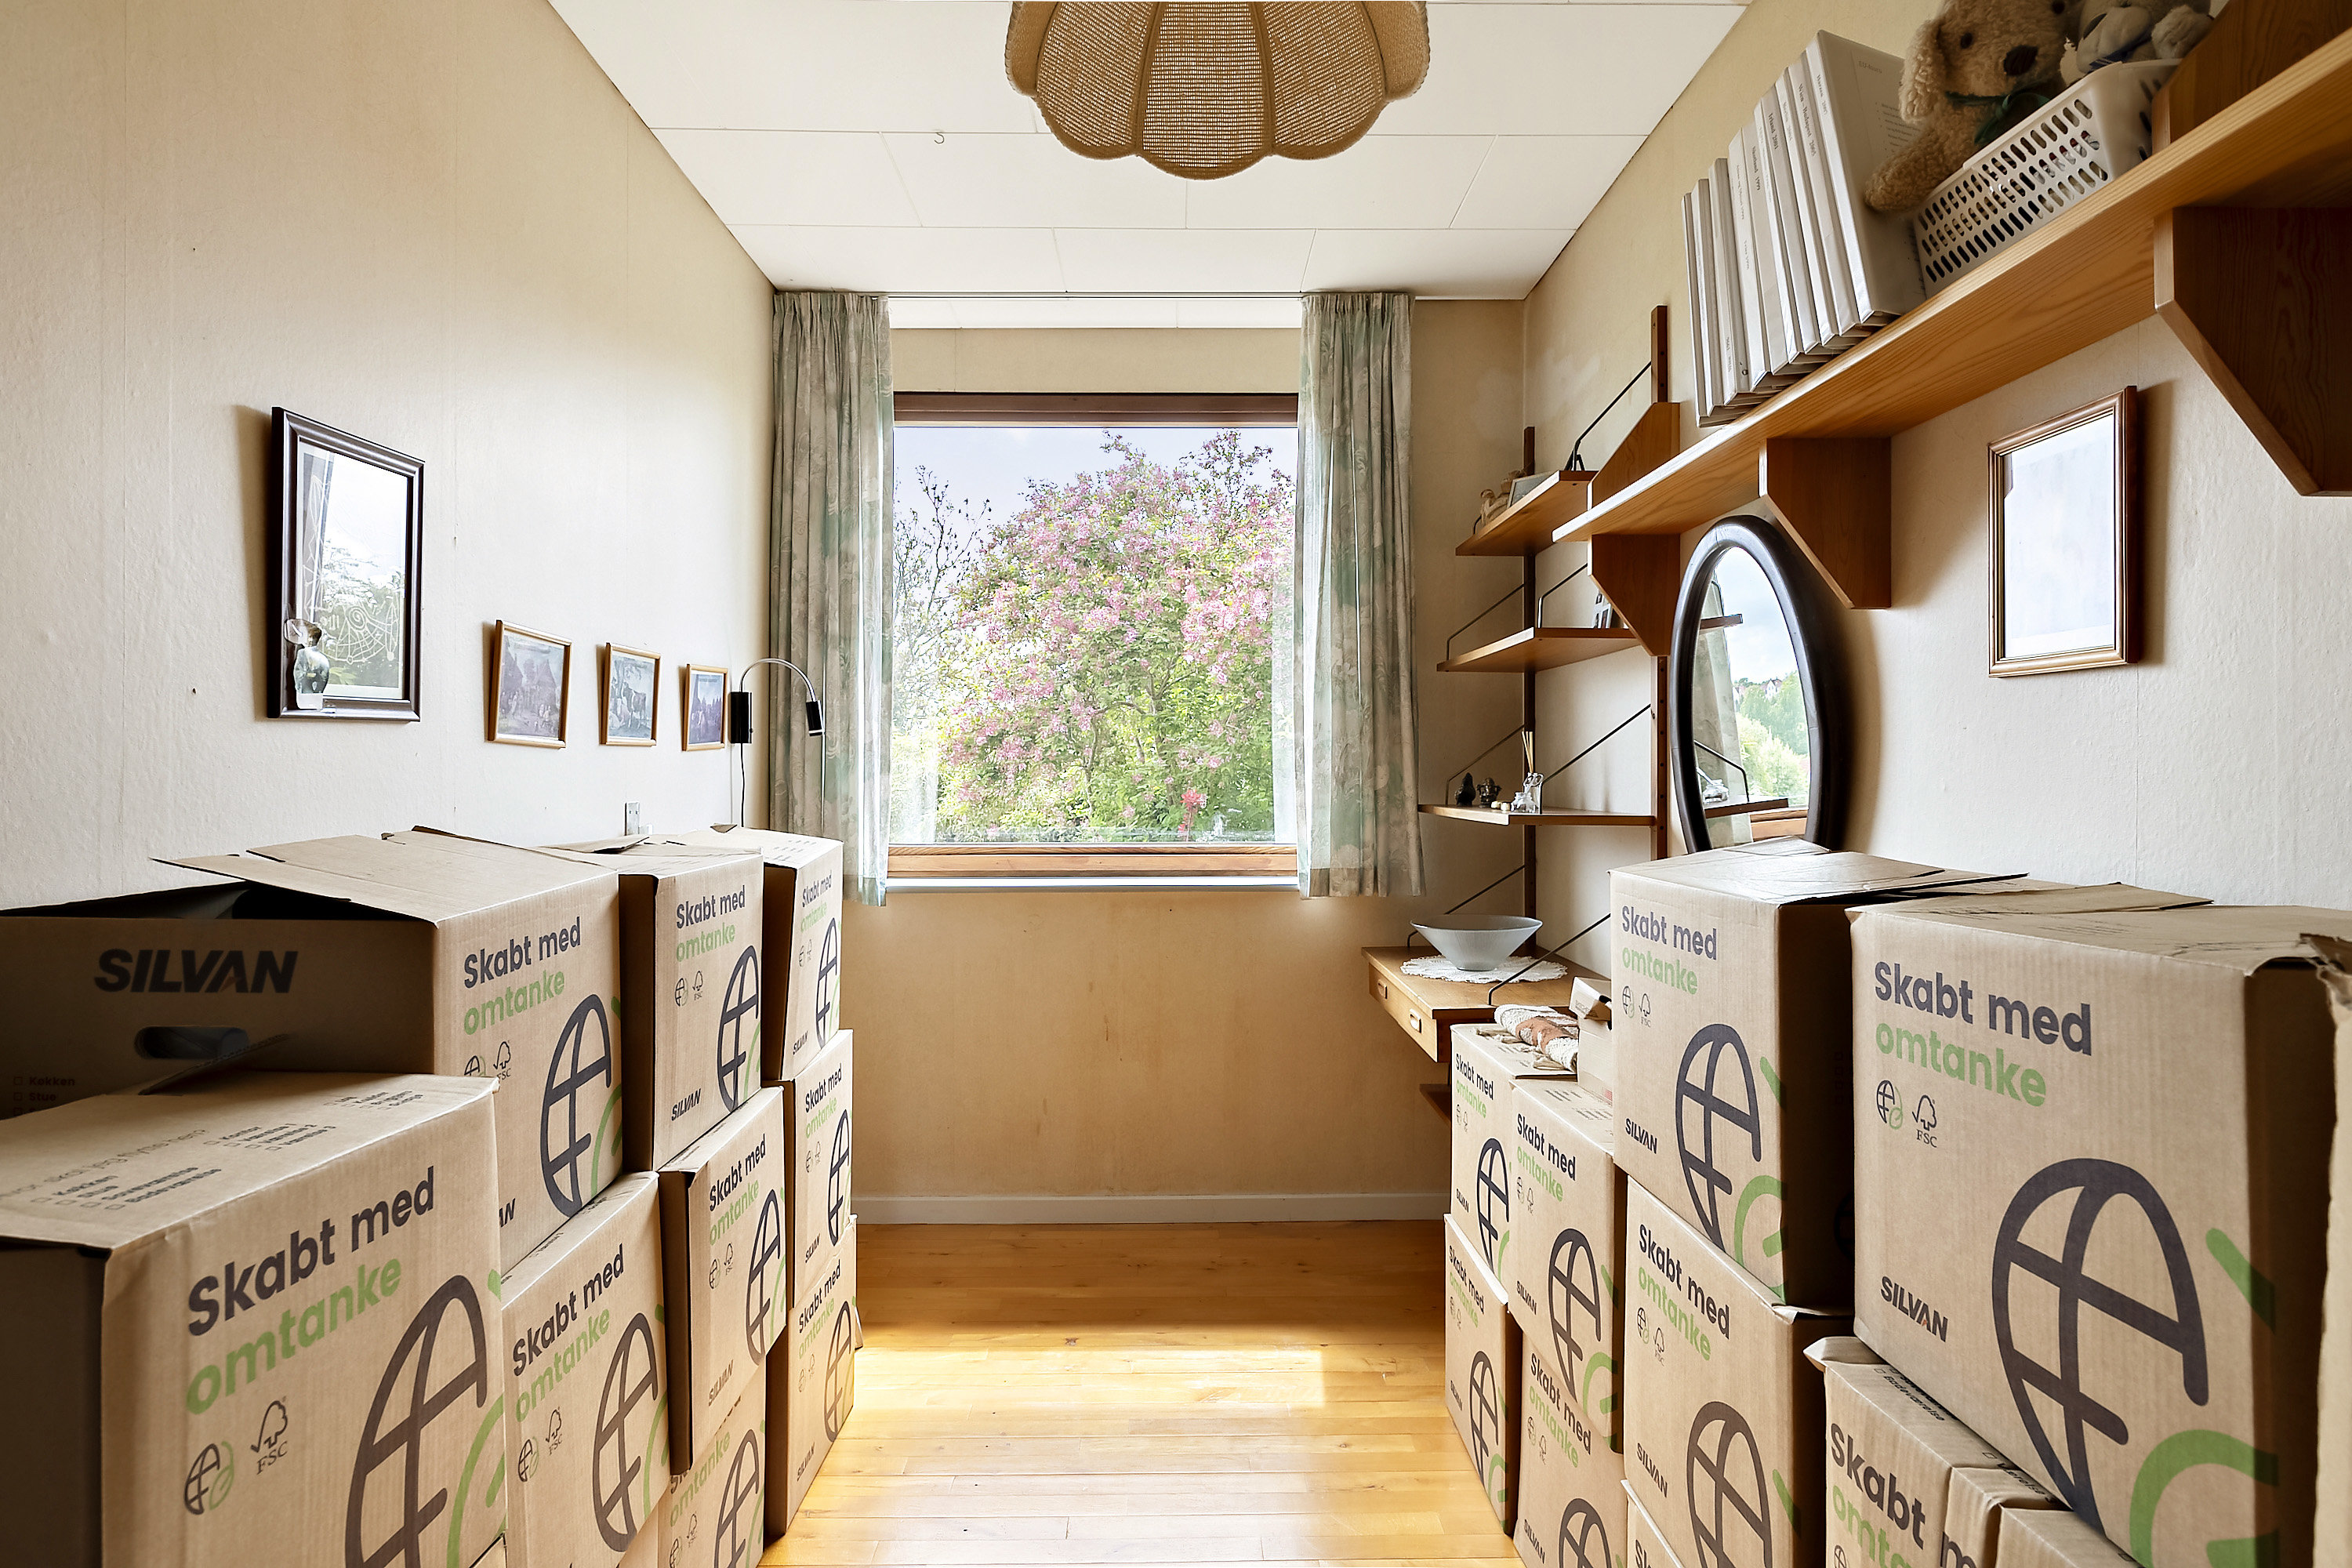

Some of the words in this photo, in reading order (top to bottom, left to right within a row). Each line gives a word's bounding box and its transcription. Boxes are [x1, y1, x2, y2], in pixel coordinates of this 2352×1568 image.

[677, 895, 716, 928] Skabt
[720, 885, 745, 915] med
[801, 903, 826, 932] omtanke
[803, 881, 818, 907] Skabt
[818, 875, 831, 897] med
[465, 936, 531, 988] Skabt
[539, 916, 580, 960] med
[677, 923, 735, 961] omtanke
[1623, 906, 1667, 944] Skabt
[1674, 925, 1716, 960] med
[94, 949, 297, 993] SILVAN
[1623, 948, 1697, 995] omtanke
[464, 971, 564, 1035] omtanke
[1875, 962, 1973, 1024] Skabt
[1989, 995, 2091, 1056] med
[793, 1031, 808, 1054] SILVAN
[1876, 1023, 2046, 1106] omtanke
[29, 1076, 76, 1086] Køkken
[29, 1092, 56, 1102] Stue
[672, 1088, 701, 1120] SILVAN
[806, 1080, 826, 1112] Skabt
[829, 1065, 841, 1092] med
[1457, 1054, 1474, 1083] Skabt
[1477, 1074, 1493, 1100] med
[1457, 1080, 1486, 1117] omtanke
[806, 1099, 837, 1138] omtanke
[1626, 1119, 1657, 1154] SILVAN
[1917, 1130, 1936, 1148] FSC
[710, 1160, 742, 1211] Skabt
[746, 1134, 765, 1175] med
[1517, 1113, 1545, 1155] Skabt
[1548, 1144, 1575, 1181] med
[1518, 1146, 1563, 1201] omtanke
[711, 1181, 759, 1244] omtanke
[188, 1218, 335, 1336] Skabt
[352, 1166, 434, 1252] med
[800, 1296, 822, 1333] Skabt
[825, 1259, 840, 1297] med
[1450, 1246, 1467, 1286] Skabt
[1469, 1279, 1483, 1314] med
[1450, 1272, 1478, 1327] omtanke
[1517, 1281, 1537, 1315] SILVAN
[1639, 1225, 1682, 1291] Skabt
[1688, 1276, 1729, 1339] med
[187, 1258, 401, 1414] omtanke
[514, 1291, 577, 1376] Skabt
[583, 1243, 623, 1309] med
[798, 1298, 834, 1357] omtanke
[1639, 1267, 1710, 1360] omtanke
[1881, 1276, 1947, 1342] SILVAN
[516, 1309, 609, 1421] omtanke
[709, 1359, 733, 1406] SILVAN
[1450, 1381, 1462, 1410] SILVAN
[1530, 1352, 1561, 1411] Skabt
[1565, 1403, 1591, 1454] med
[1883, 1375, 1945, 1422] Badeværelse
[549, 1434, 563, 1455] FSC
[1530, 1386, 1578, 1468] omtanke
[256, 1444, 288, 1475] FSC
[670, 1432, 731, 1527] omtanke
[797, 1446, 815, 1481] SILVAN
[1637, 1443, 1667, 1497] SILVAN
[1831, 1424, 1925, 1549] Skabt
[1525, 1519, 1544, 1564] SILVAN
